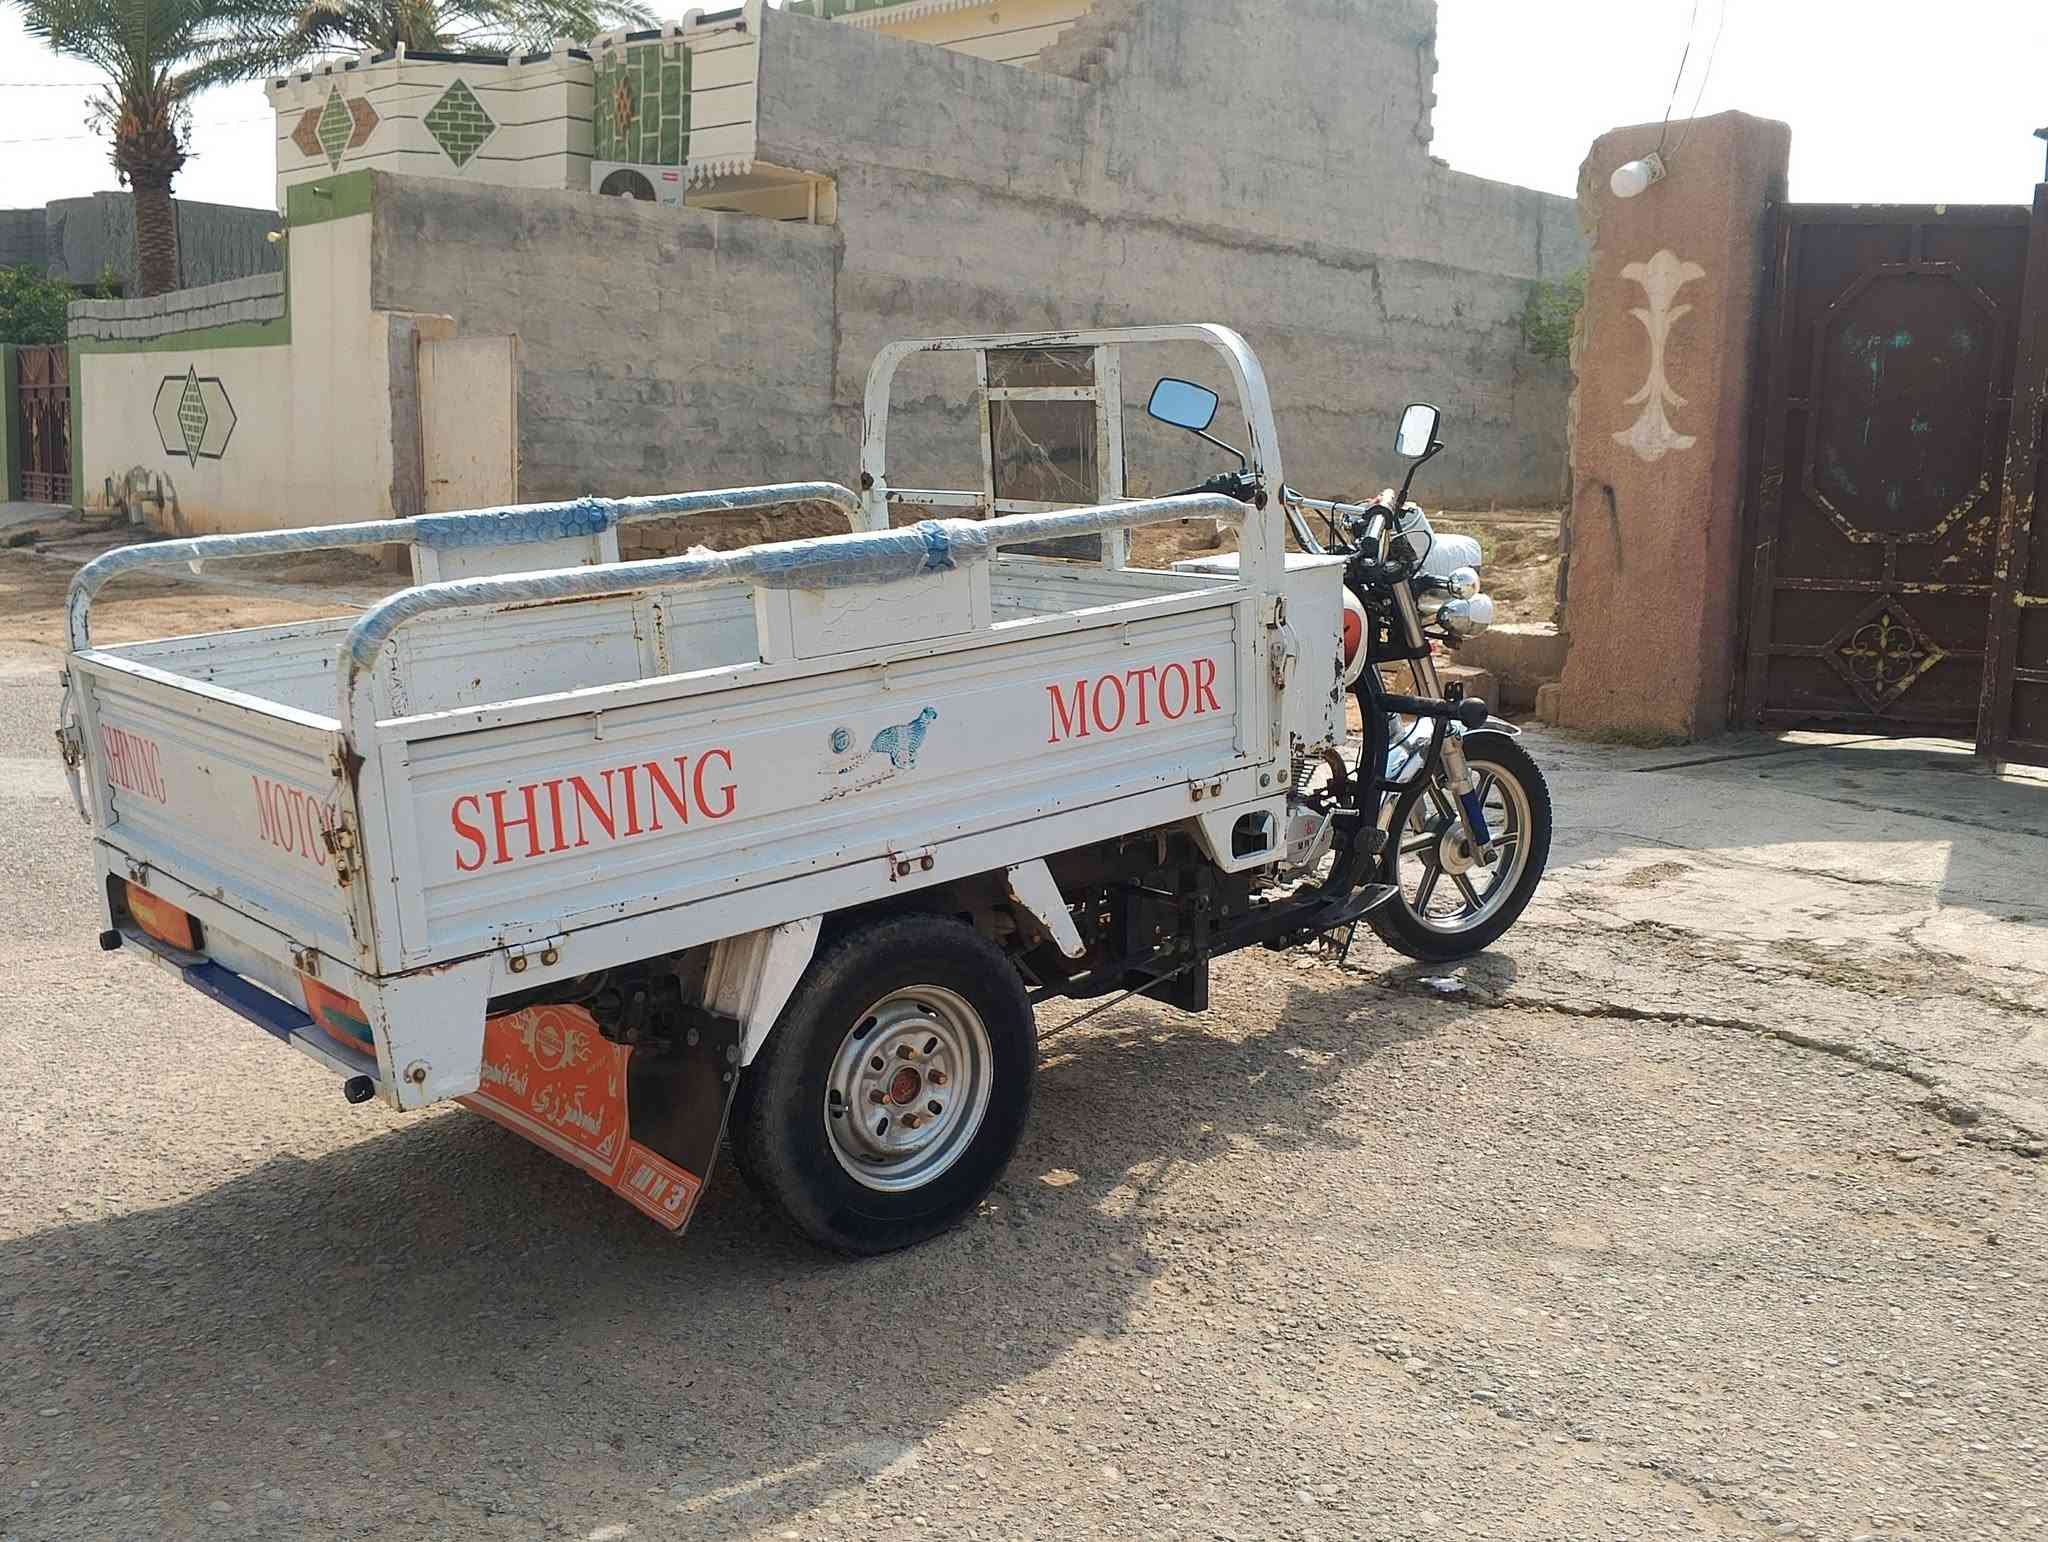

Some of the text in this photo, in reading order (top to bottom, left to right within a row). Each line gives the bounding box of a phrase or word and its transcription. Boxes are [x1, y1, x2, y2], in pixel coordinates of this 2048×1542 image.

[101, 722, 167, 804] SHINING
[451, 657, 1221, 872] SHINING MOTOR
